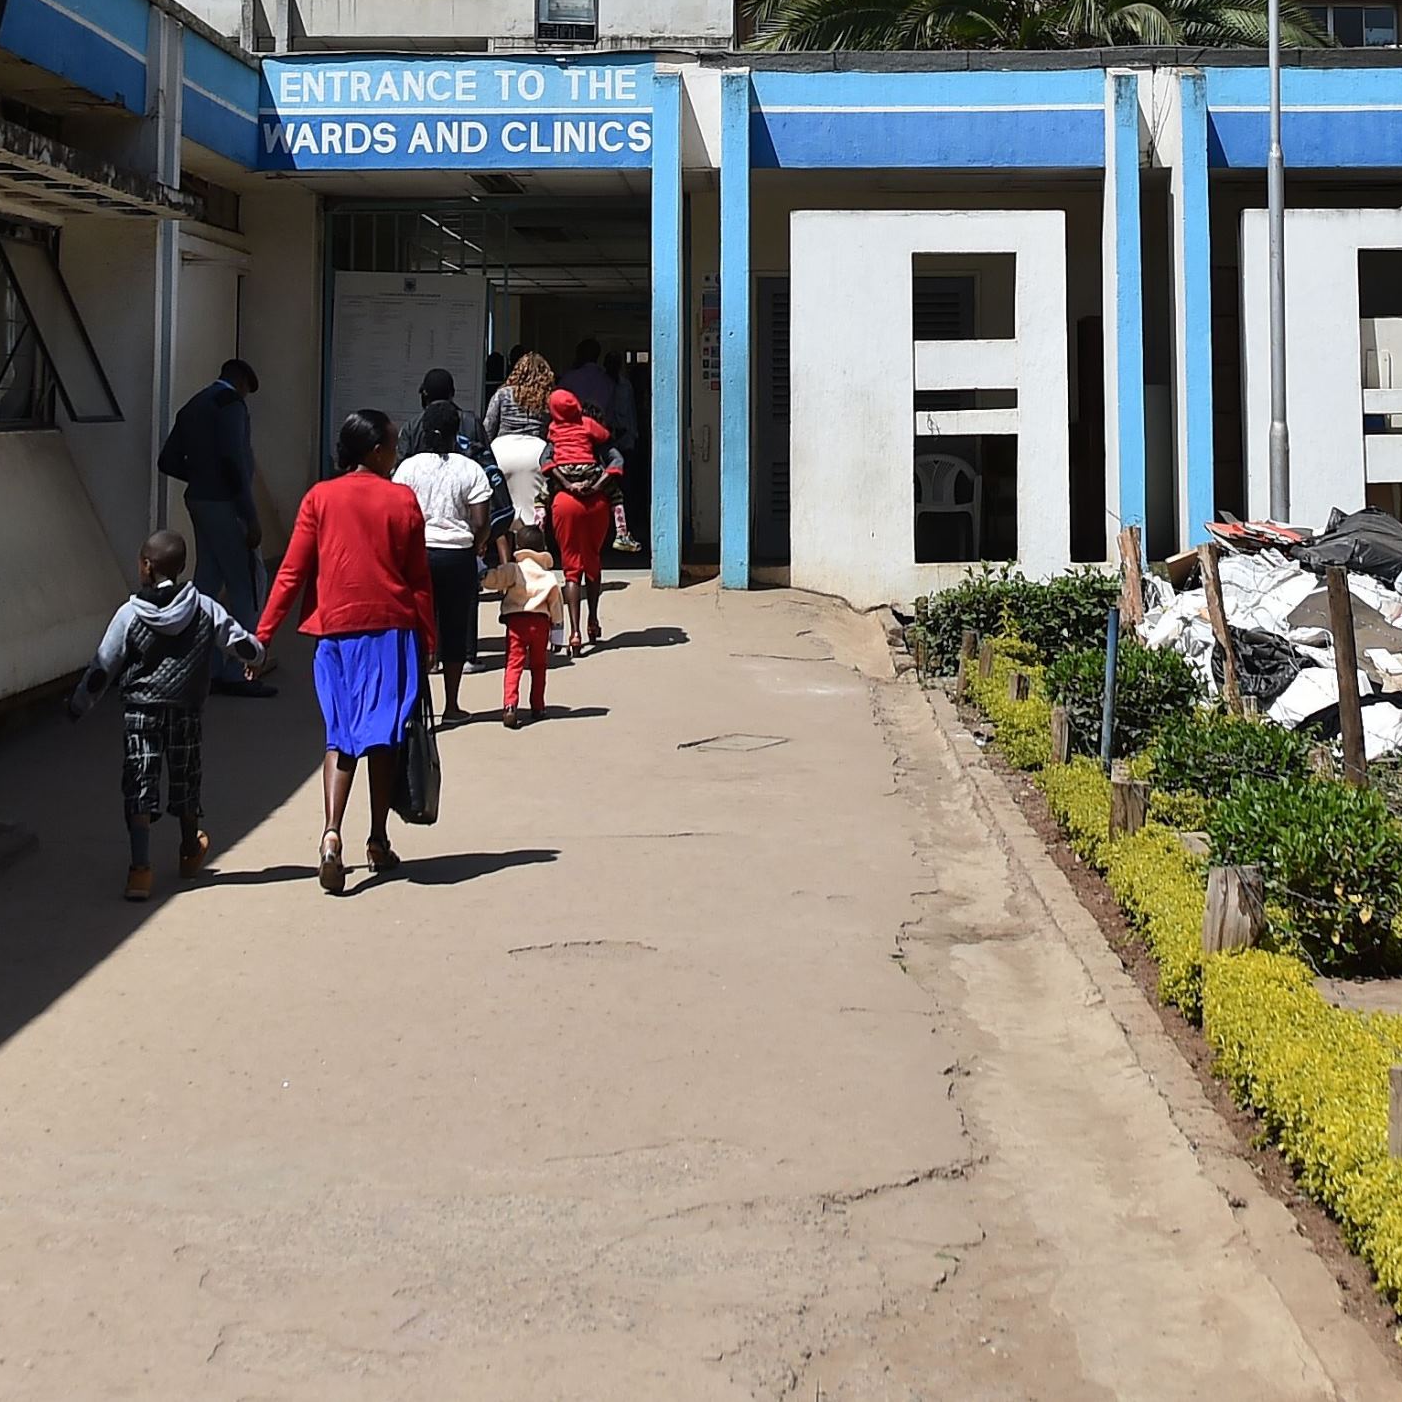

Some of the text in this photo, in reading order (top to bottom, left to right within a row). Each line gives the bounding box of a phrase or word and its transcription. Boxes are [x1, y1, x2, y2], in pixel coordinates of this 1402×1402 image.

[279, 69, 637, 103] ENTRANCE TO THE
[263, 121, 652, 155] WARDS AND CLINICS
